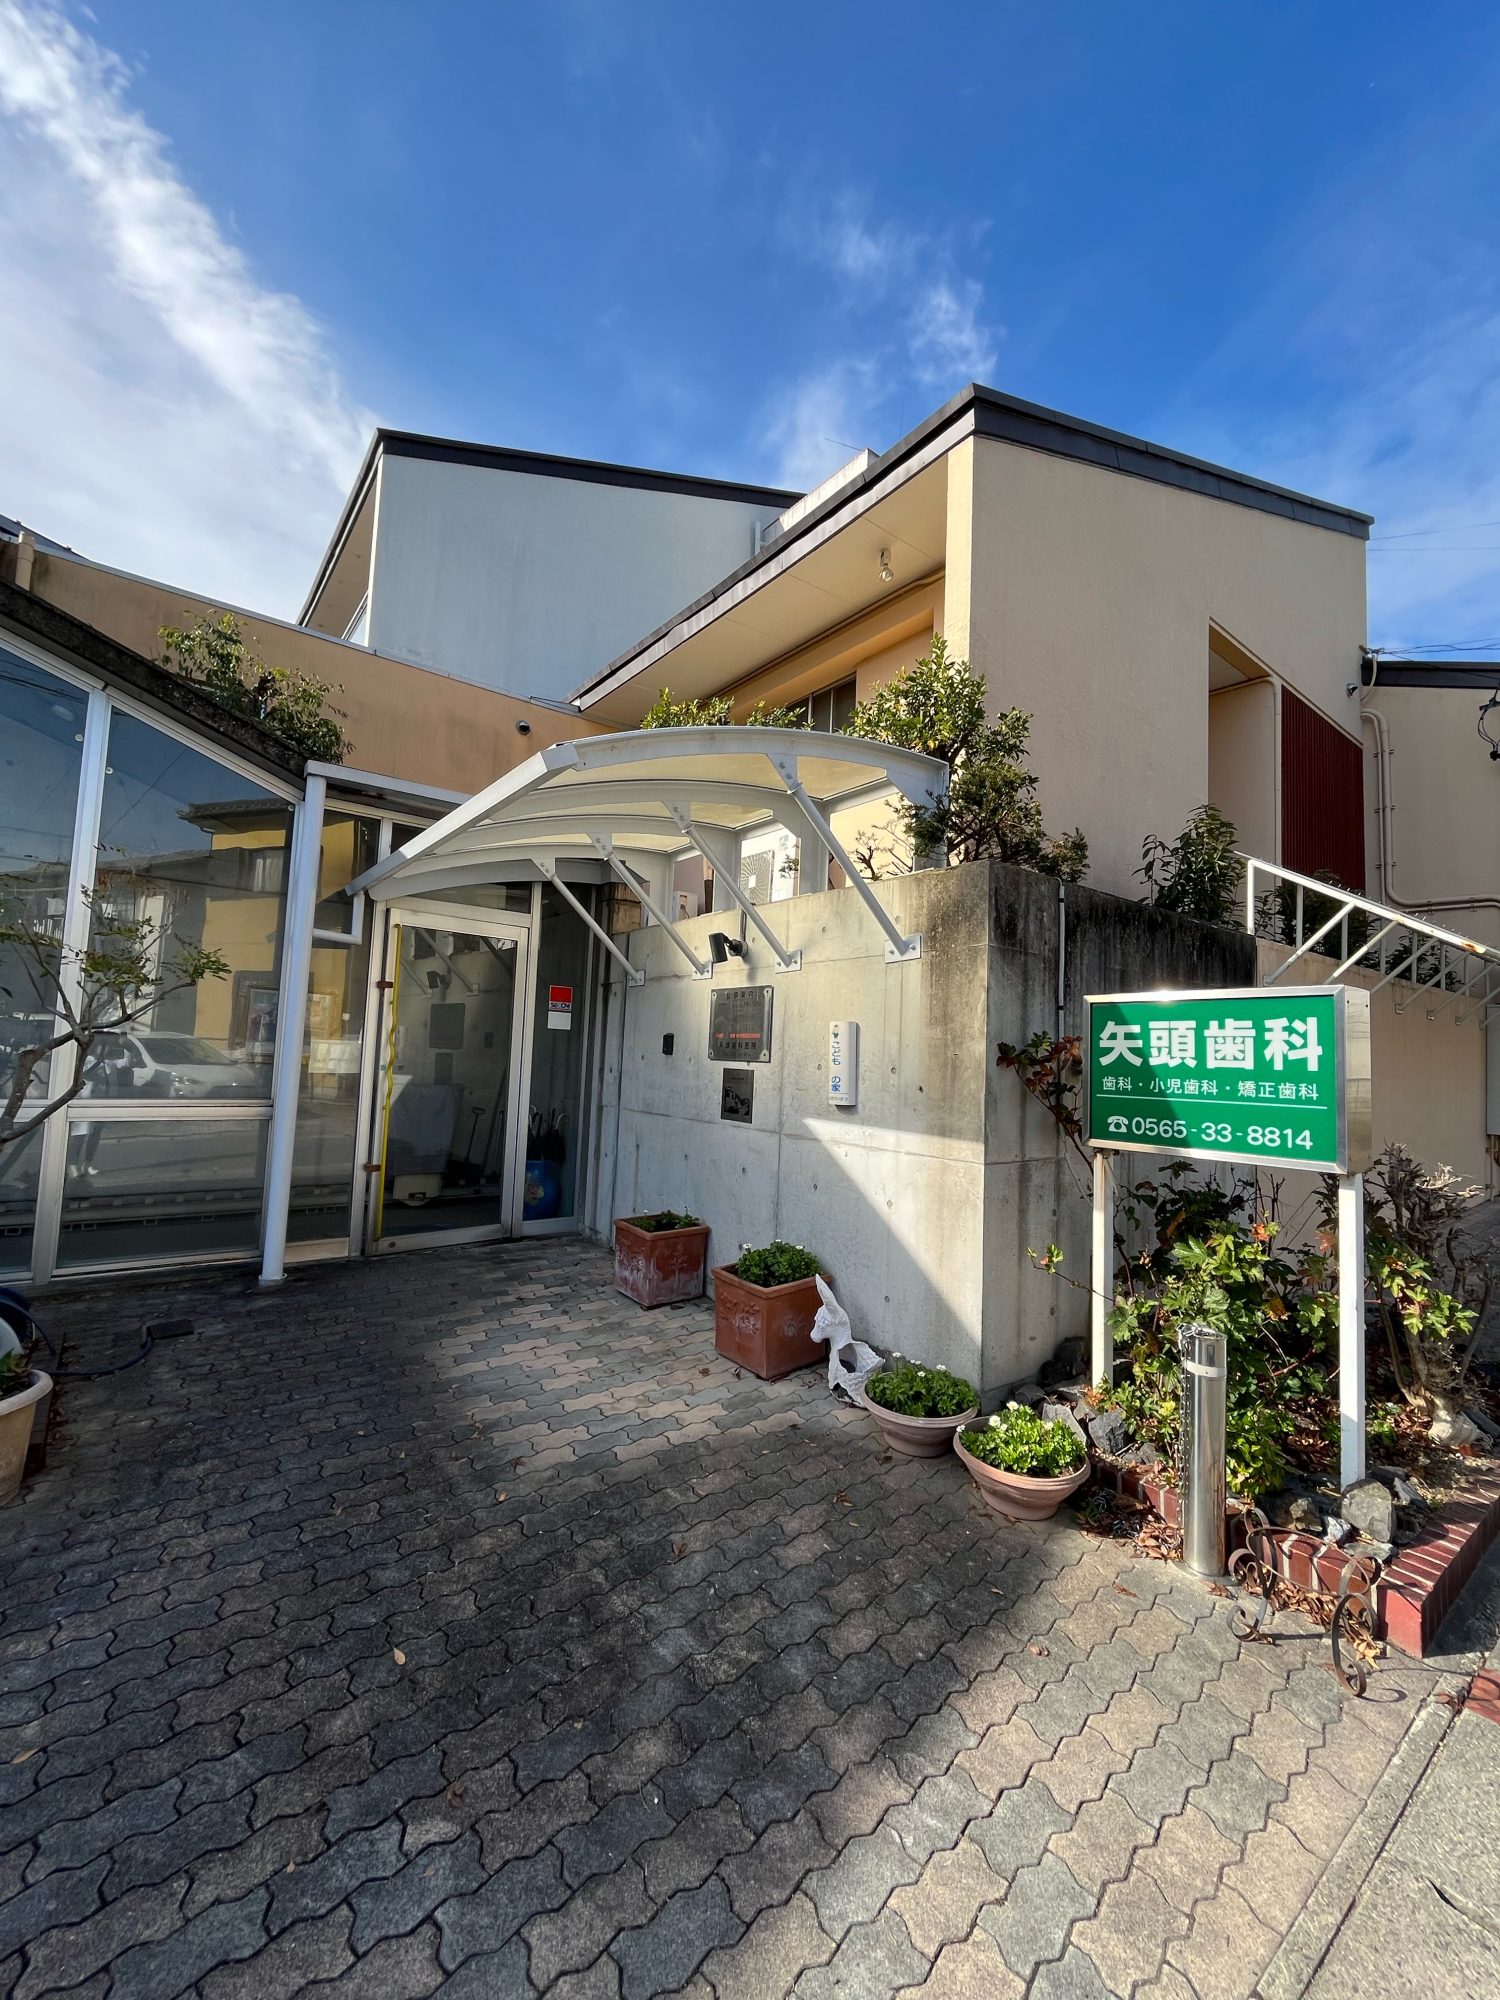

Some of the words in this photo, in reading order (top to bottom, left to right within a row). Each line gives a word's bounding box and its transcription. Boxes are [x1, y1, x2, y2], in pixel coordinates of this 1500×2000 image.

[1099, 1017, 1323, 1072] 矢頭歯科
[1102, 1076, 1319, 1101] 歯科・小児歯科・矯正歯科
[1131, 1116, 1313, 1151] 0565-33-8814
